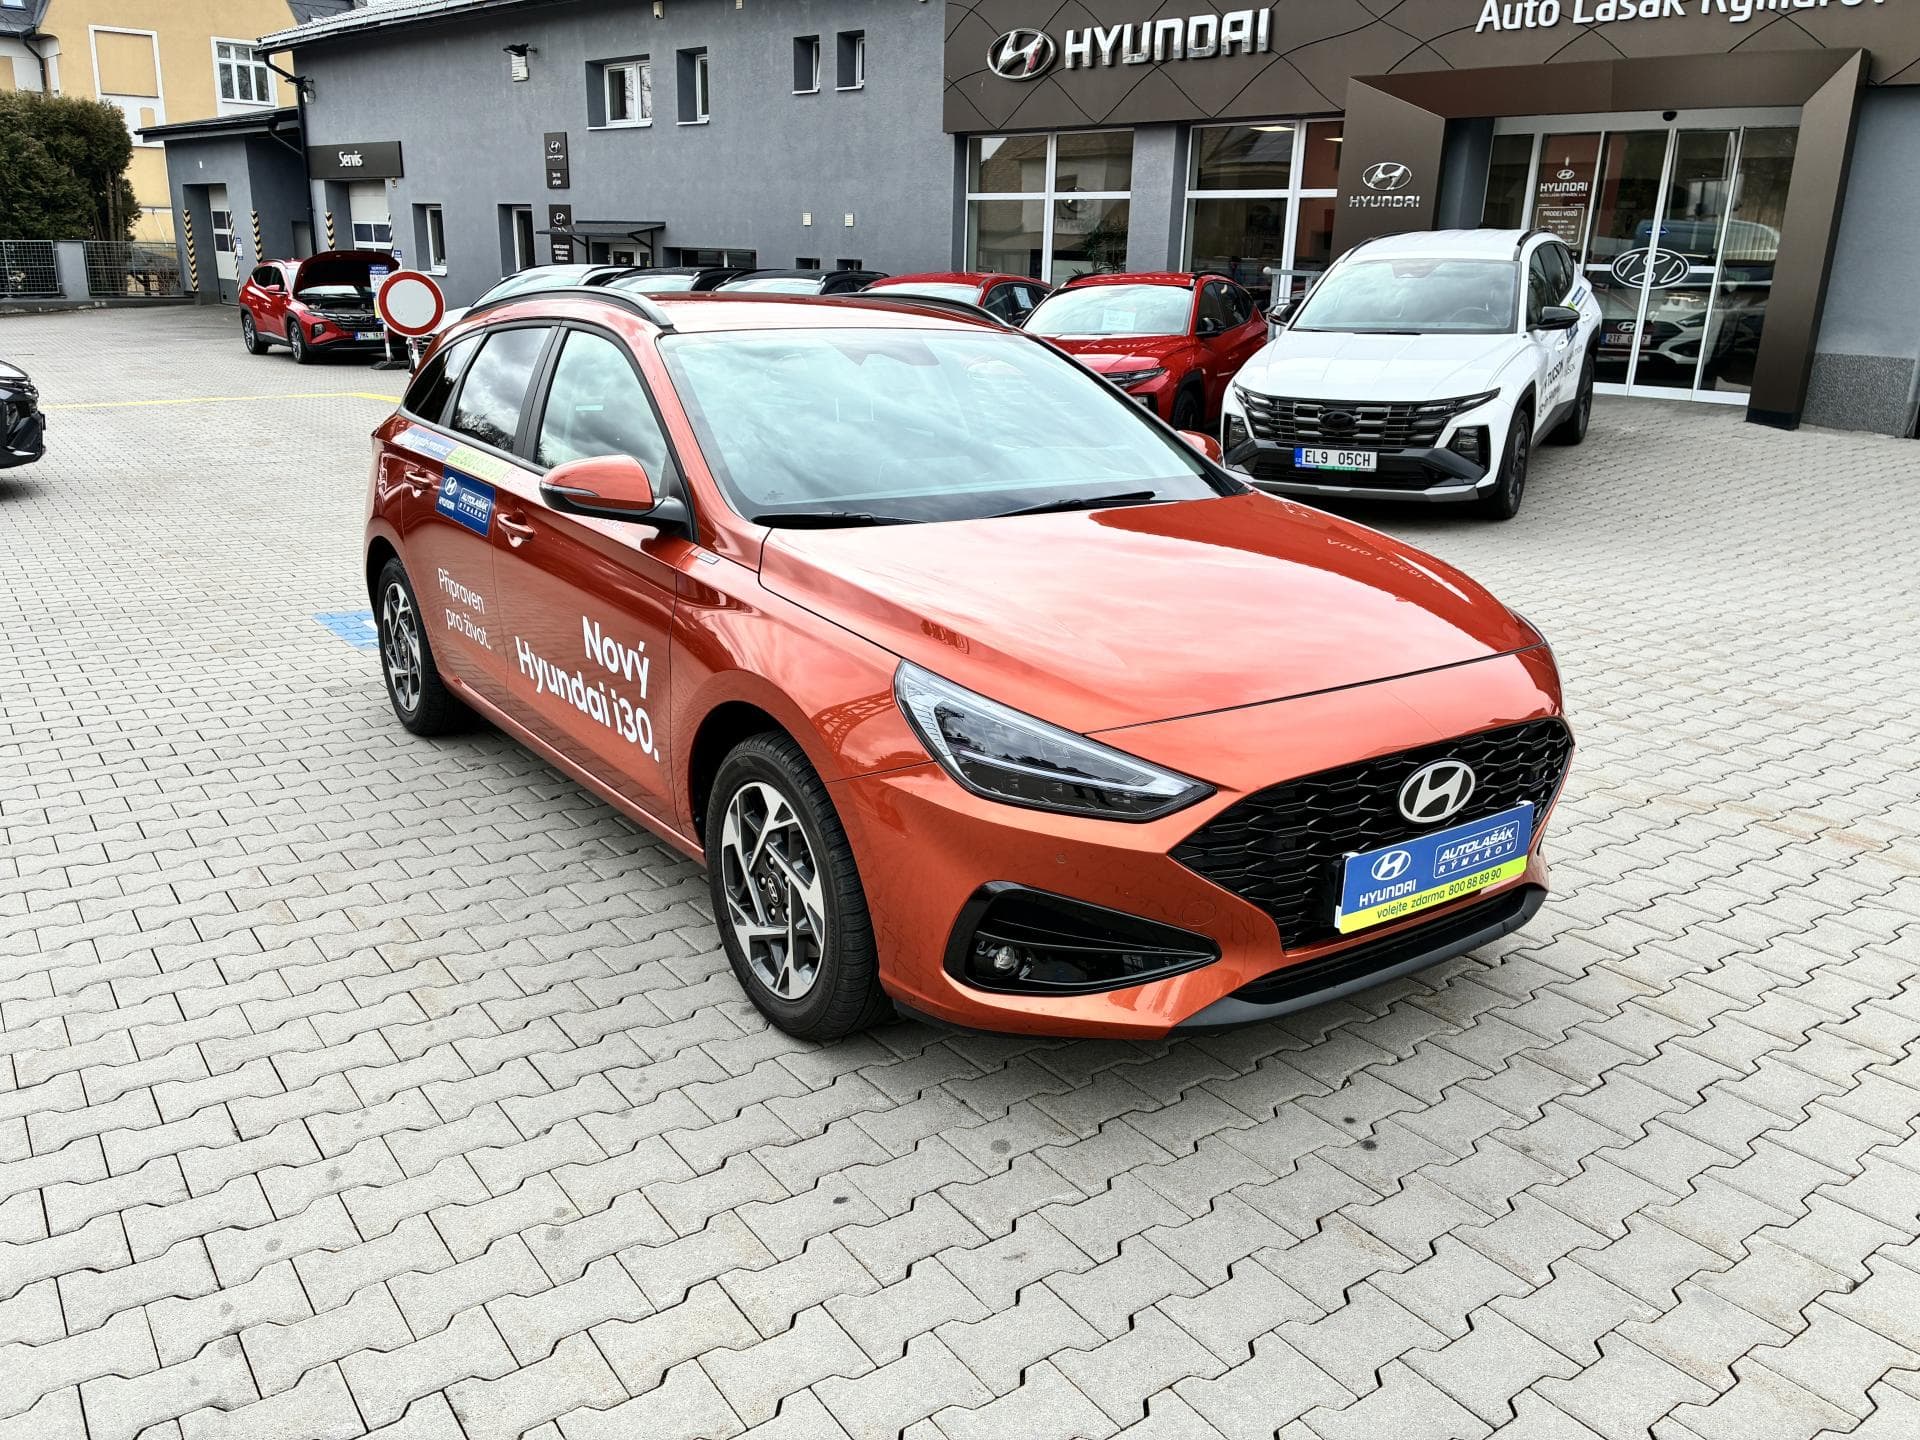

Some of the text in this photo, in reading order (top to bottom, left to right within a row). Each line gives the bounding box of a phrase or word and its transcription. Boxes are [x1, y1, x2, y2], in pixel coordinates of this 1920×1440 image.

[1474, 0, 1561, 33] Auto
[1065, 8, 1272, 69] HYUNDAI
[338, 150, 363, 167] Servis
[1348, 195, 1421, 208] HYUNDAI
[1540, 182, 1588, 192] HYUNDAI
[1305, 450, 1371, 467] EL9 05CH
[437, 567, 485, 616] Připraven
[445, 608, 492, 650] pro život.
[582, 616, 650, 699] Nový
[515, 636, 661, 763] Hyundai i30.
[1438, 842, 1513, 874] RÝMAŘOV
[1439, 827, 1514, 862] AUTOLAŠÁK
[1359, 880, 1416, 907] HYUNDAI
[1376, 868, 1502, 919] volejte zdarma 800 88 89 90
